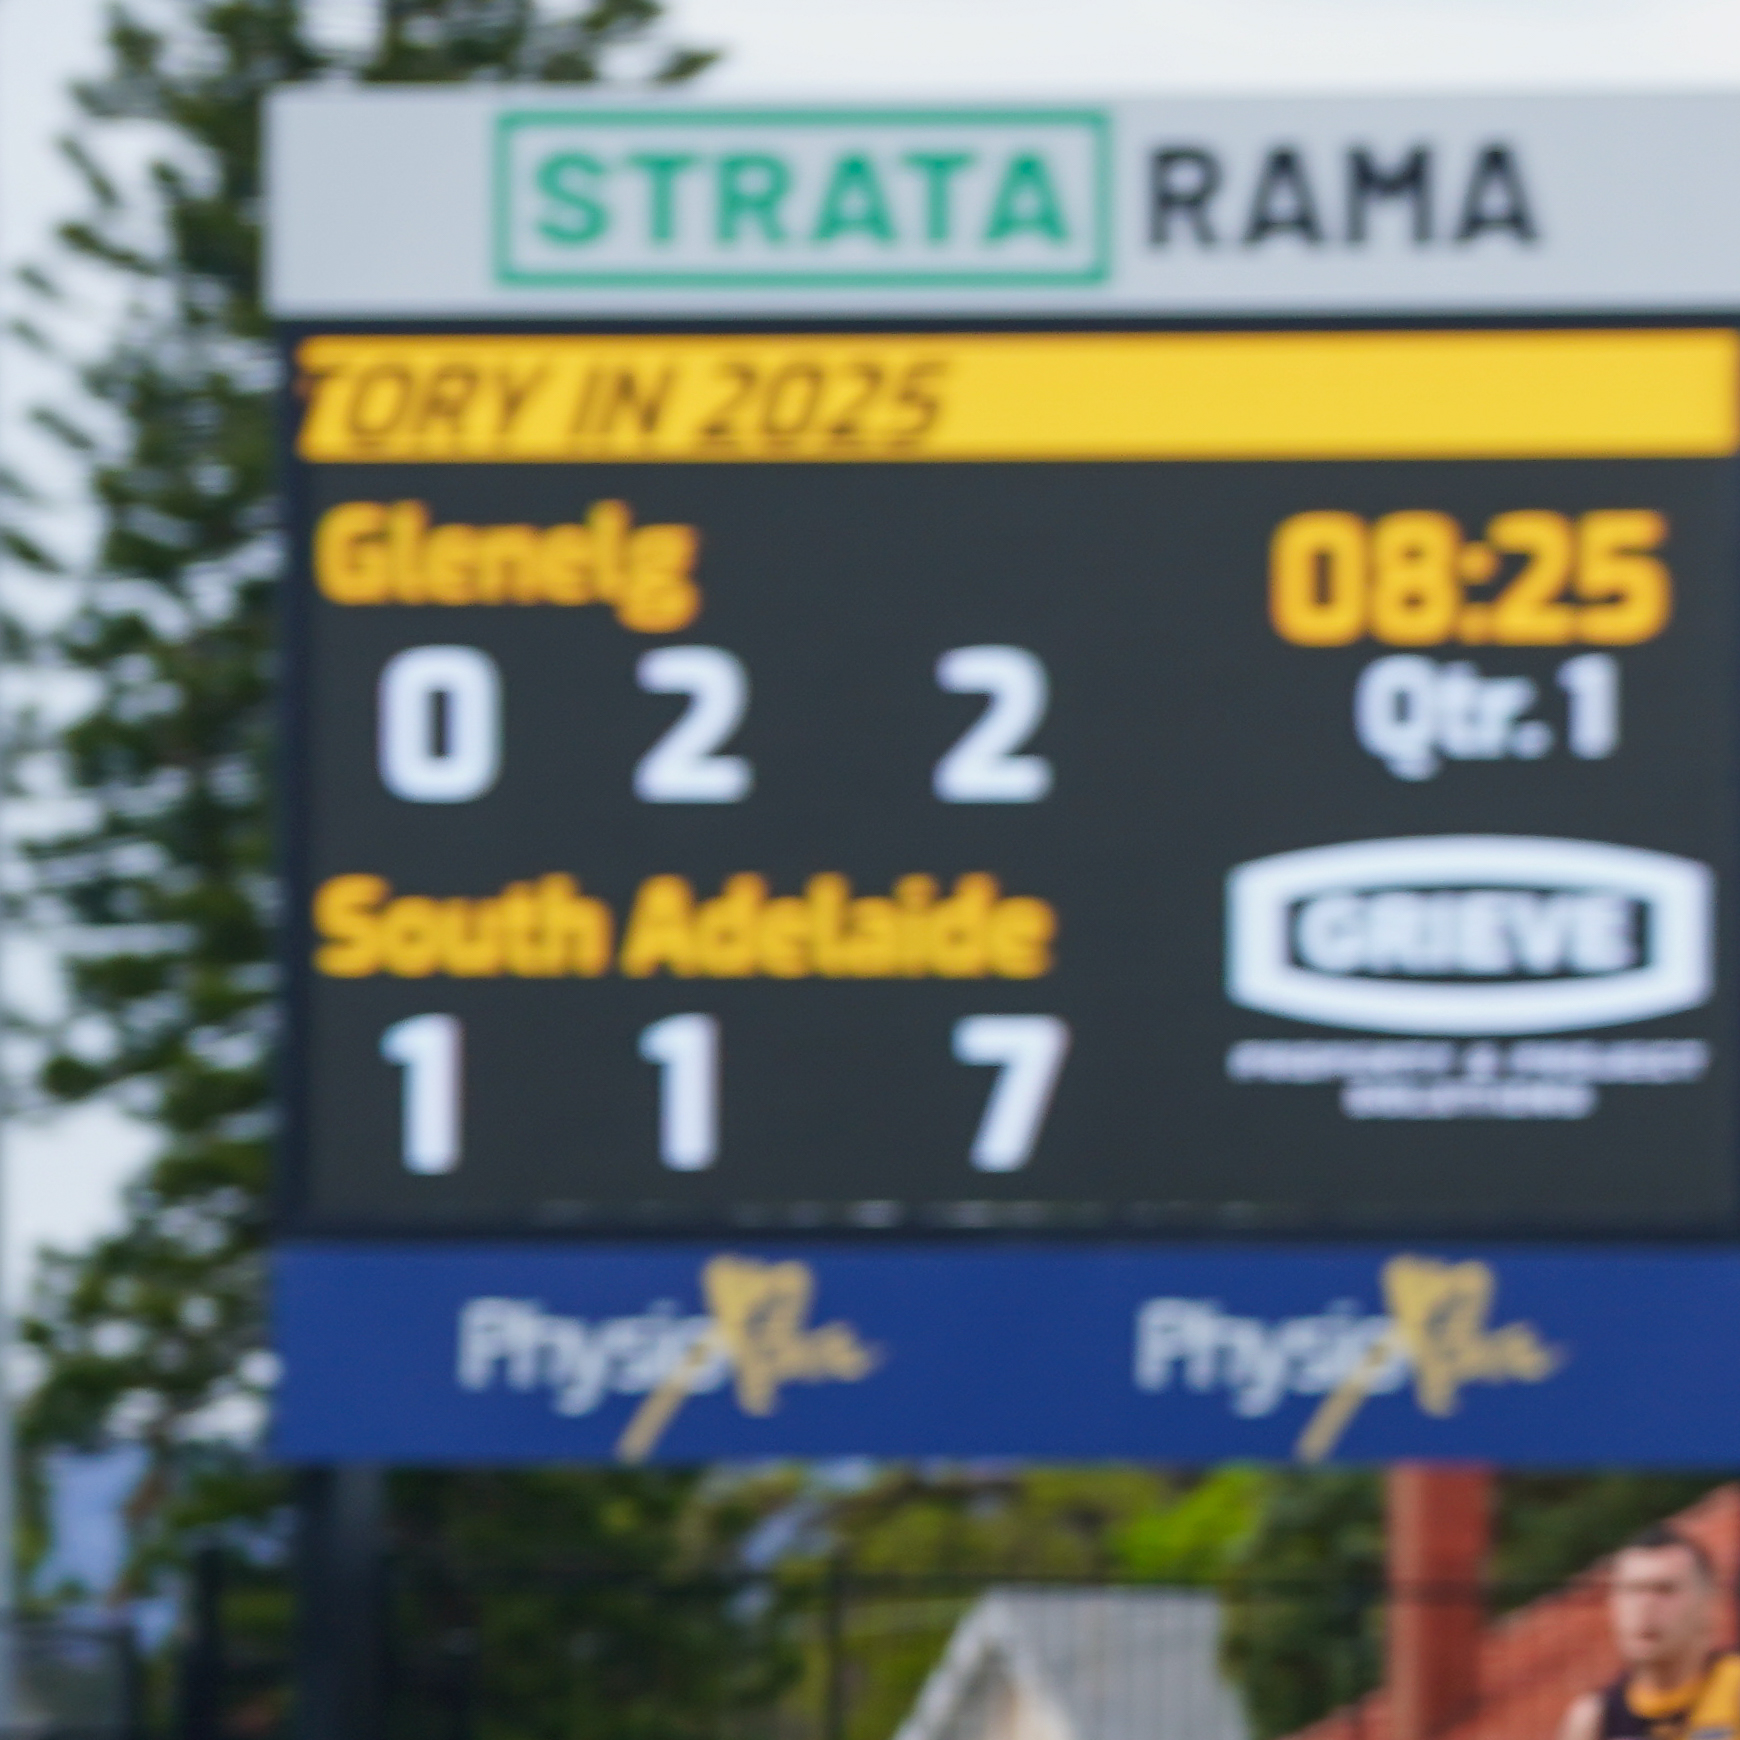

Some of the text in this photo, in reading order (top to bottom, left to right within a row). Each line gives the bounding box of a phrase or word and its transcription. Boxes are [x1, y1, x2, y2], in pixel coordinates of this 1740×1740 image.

[532, 143, 1543, 250] STRATA RAMA
[570, 360, 677, 440] IN
[700, 358, 952, 441] 2025
[312, 499, 701, 634] Glenelg
[1269, 509, 1673, 647] 08:25
[376, 643, 1054, 804] 0 2 2
[1356, 654, 1621, 780] Qtr. 1
[311, 871, 1059, 979] South Adelaide
[1296, 891, 1640, 976] GRIEVE
[379, 1012, 1071, 1175] 1 1 7
